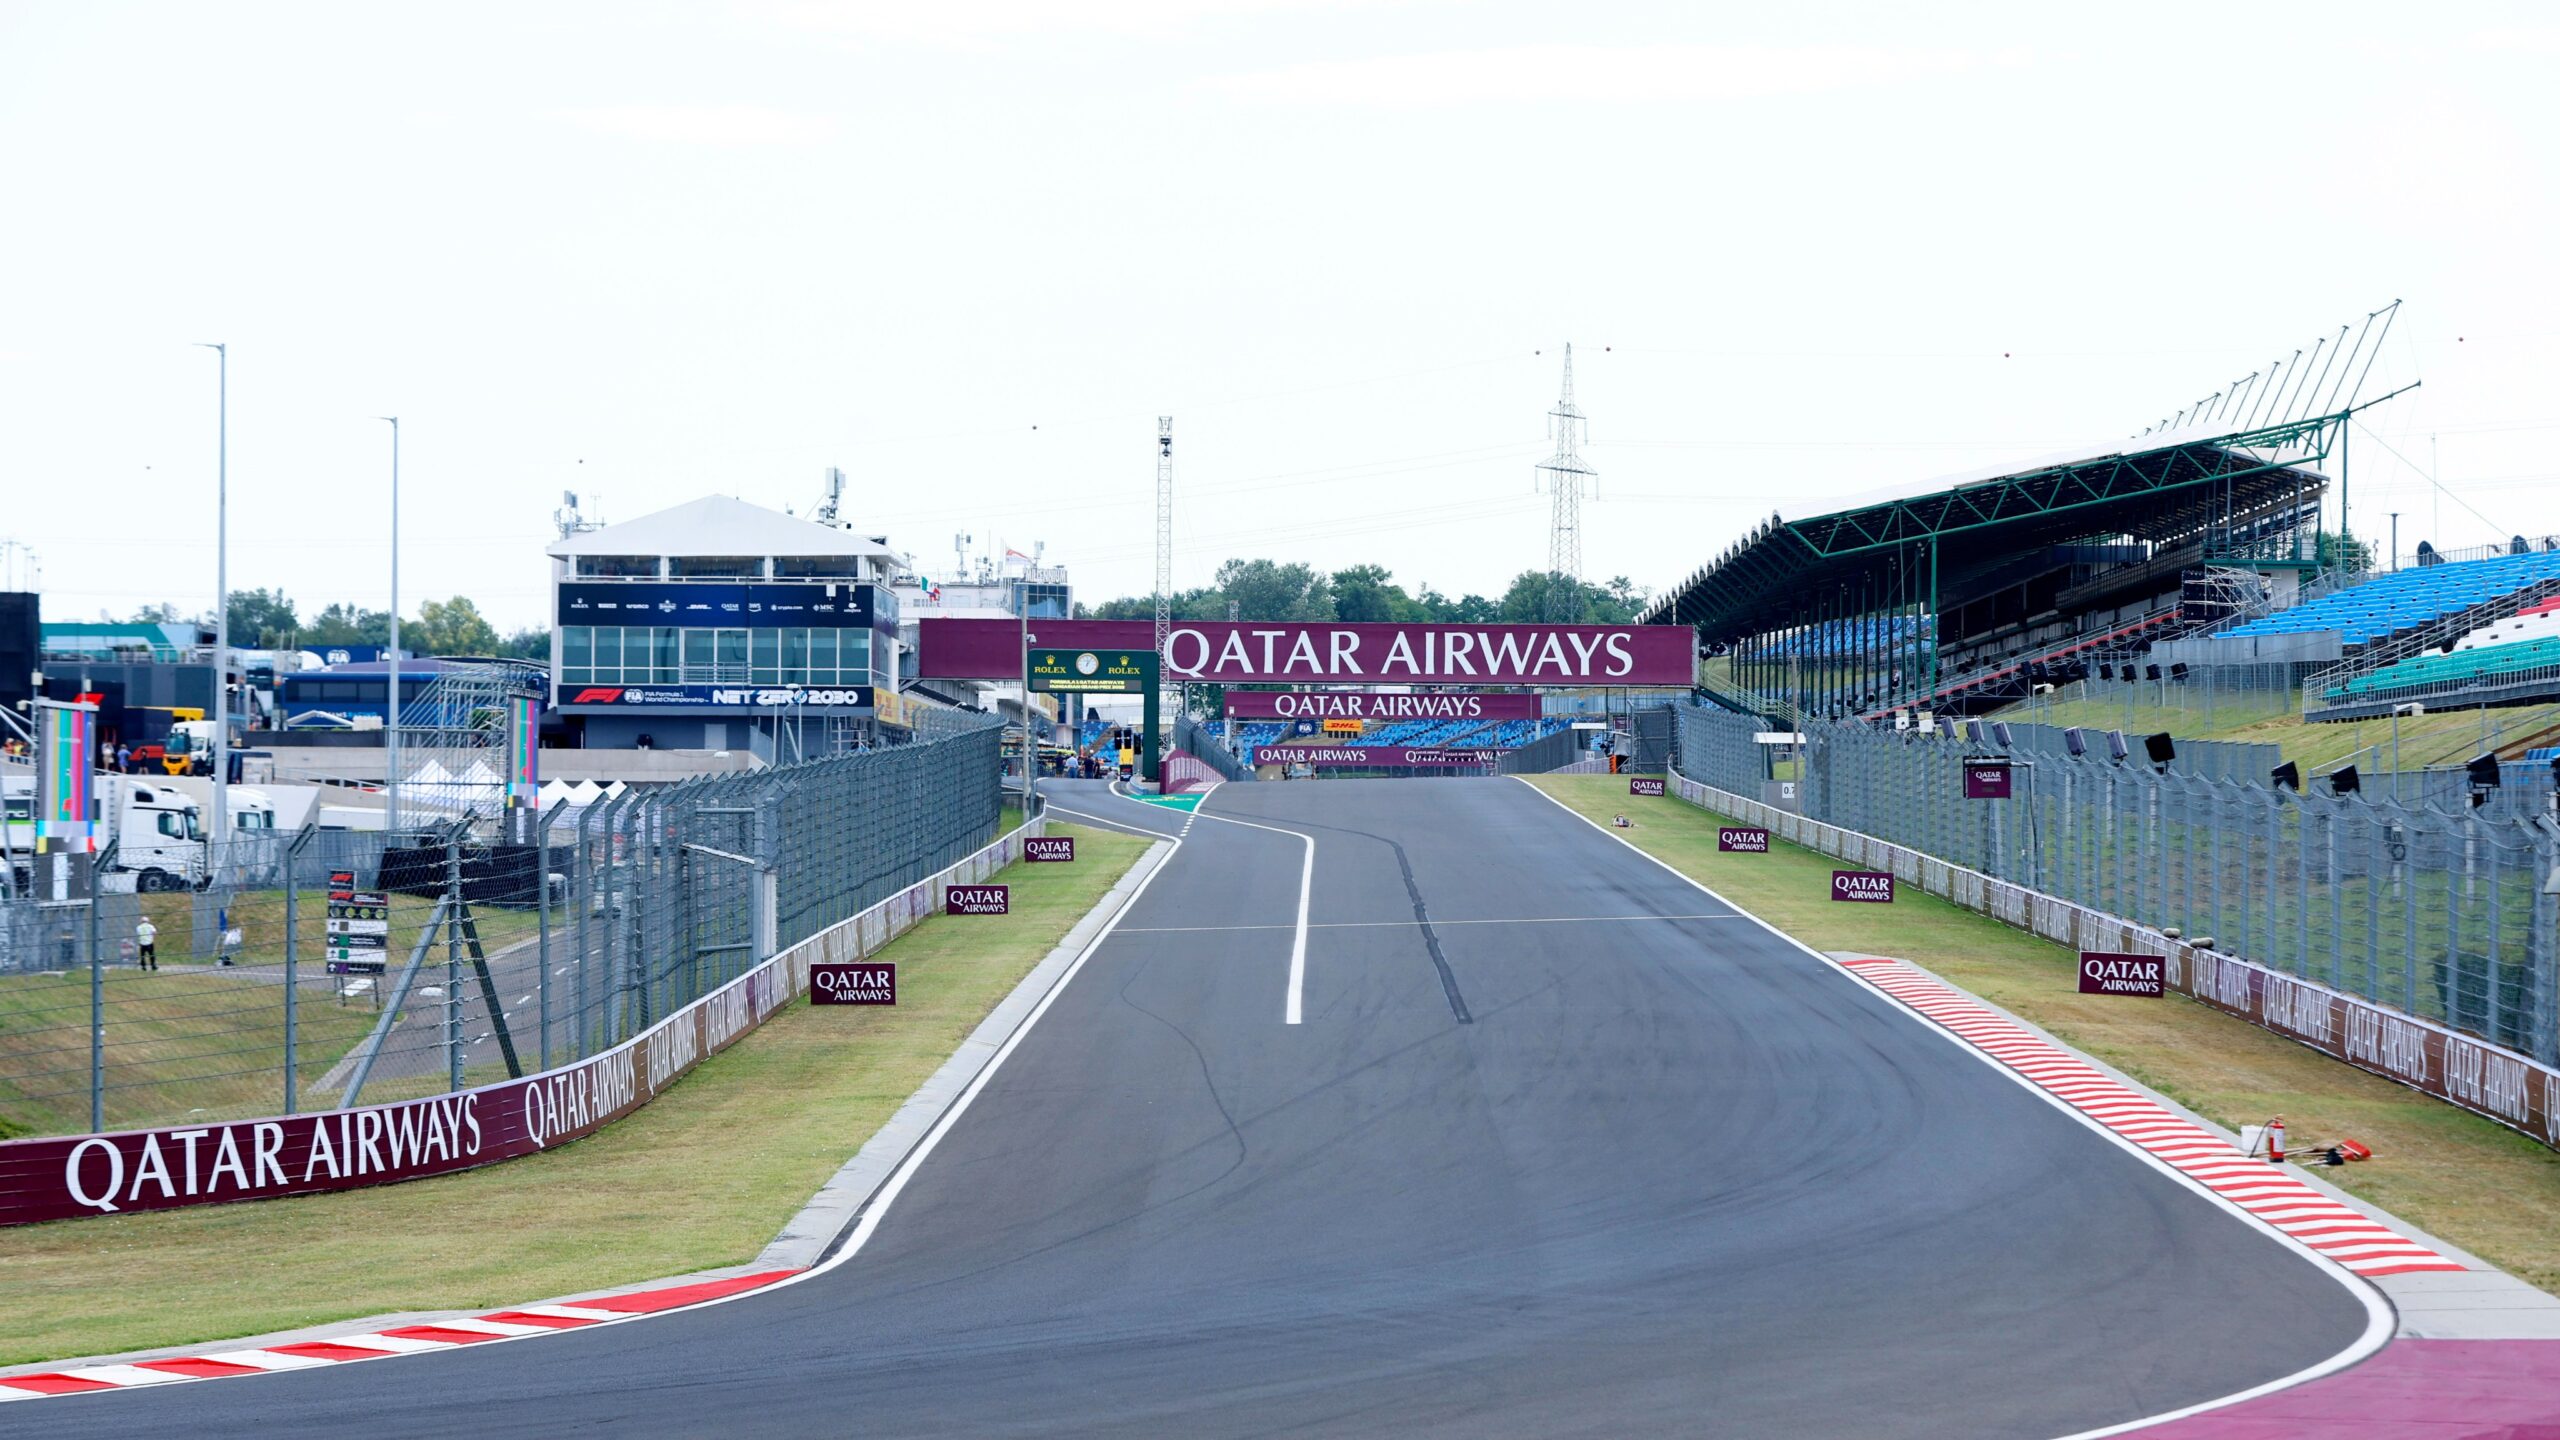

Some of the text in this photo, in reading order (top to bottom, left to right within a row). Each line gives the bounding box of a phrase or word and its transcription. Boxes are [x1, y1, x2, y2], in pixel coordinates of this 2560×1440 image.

[1165, 629, 1633, 678] QATAR AIRWAYS
[1034, 666, 1067, 674] ROLEX
[625, 690, 644, 702] FIA
[713, 690, 756, 704] NET
[808, 690, 858, 704] 2030
[1275, 695, 1481, 717] QATAR AIRWAYS
[1260, 749, 1367, 762] QATAR AIRWAYS
[1632, 780, 1662, 790] QATAR
[1640, 788, 1662, 796] AIRWAYS
[1722, 831, 1764, 844] QATAR
[1027, 842, 1070, 854] QATAR
[1732, 842, 1766, 850] AIRWAYS
[1038, 852, 1071, 860] AIRWAYS
[1835, 876, 1889, 891] QATAR
[950, 890, 1004, 906] QATAR
[1848, 890, 1890, 900] AIRWAYS
[963, 904, 1005, 913] AIRWAYS
[2085, 960, 2159, 981] QATAR
[816, 970, 890, 992] QATAR
[2101, 980, 2159, 993] AIRWAYS
[834, 989, 891, 1001] AIRWAYS
[2344, 1003, 2379, 1064] QATAR
[648, 1026, 672, 1096] QATAR
[2444, 1036, 2482, 1104] QATAR
[525, 1046, 635, 1148] QATAR AIRWAYS
[65, 1094, 481, 1212] QATAR AIRWAYS
